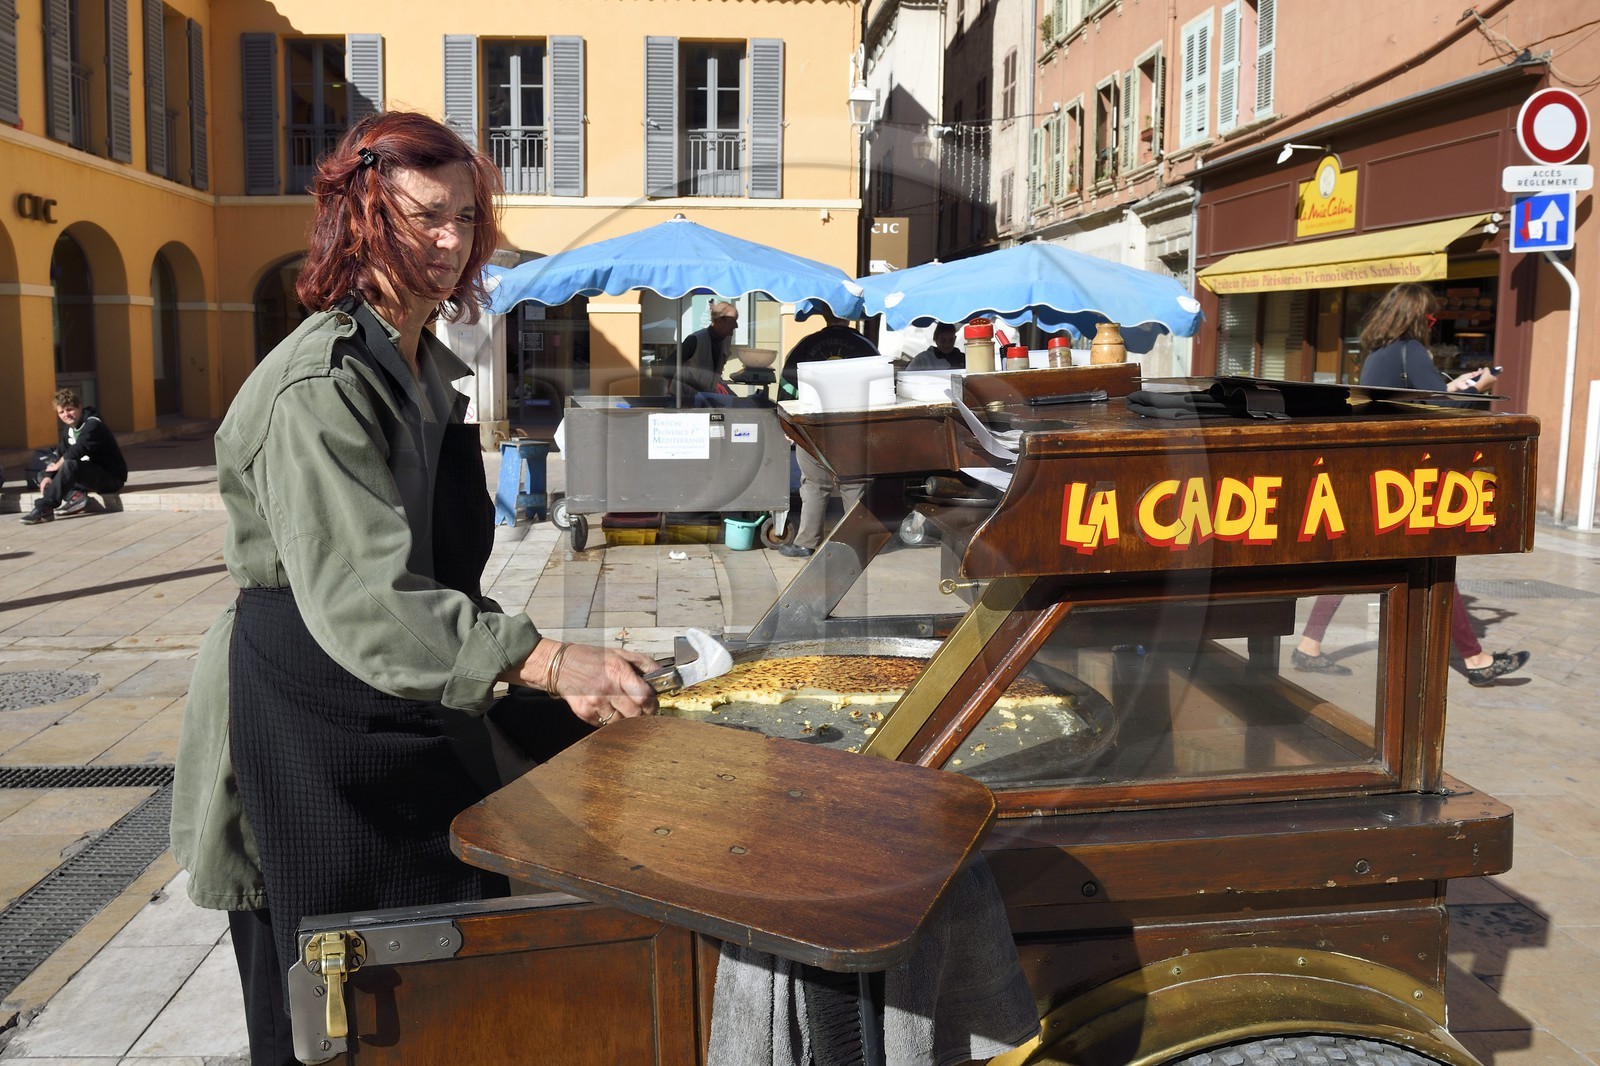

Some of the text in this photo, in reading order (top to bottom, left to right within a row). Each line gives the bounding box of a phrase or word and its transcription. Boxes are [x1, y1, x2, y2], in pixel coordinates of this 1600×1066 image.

[1517, 178, 1579, 187] RÉGLEMENTÉ
[17, 192, 58, 224] CIC
[1307, 203, 1326, 221] Mie
[871, 222, 900, 234] CIC
[1242, 277, 1260, 288] Pains
[1306, 267, 1367, 284] Viennoiseries
[1368, 260, 1421, 277] Sandwichs
[1059, 481, 1121, 555] LA
[1136, 475, 1283, 552] CADE
[1370, 451, 1498, 536] DÉDÉ
